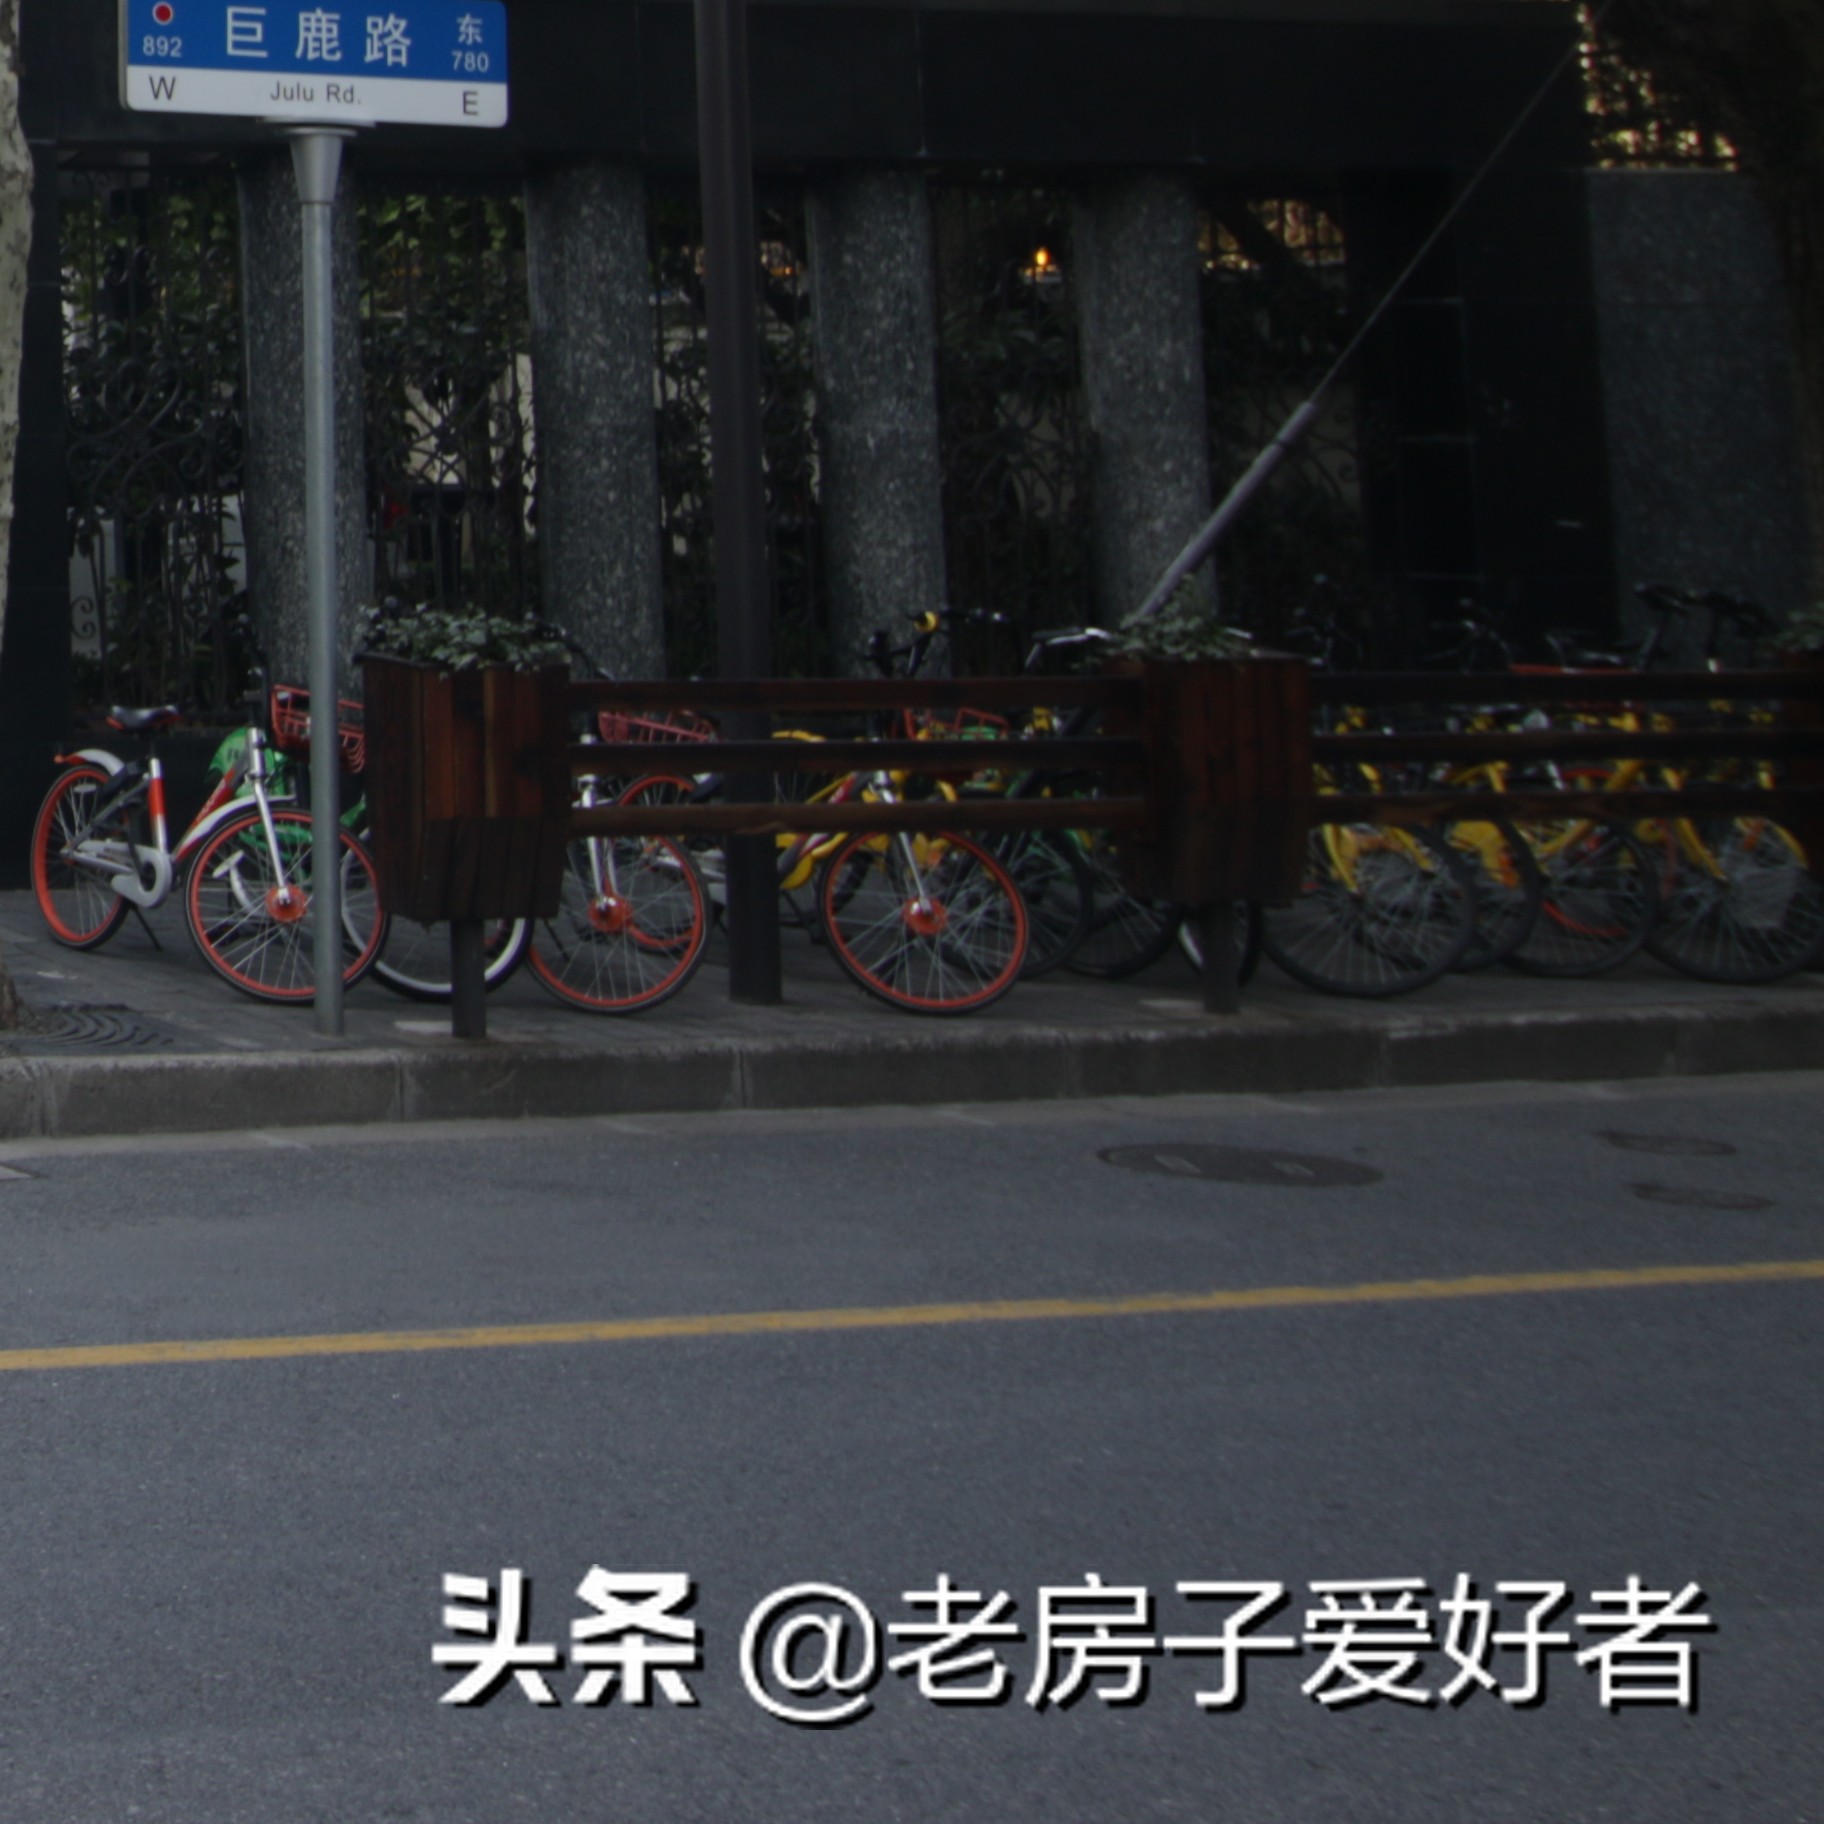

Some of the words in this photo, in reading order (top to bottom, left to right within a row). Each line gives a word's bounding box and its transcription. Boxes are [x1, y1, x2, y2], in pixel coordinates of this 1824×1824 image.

[226, 5, 412, 68] 巨鹿路
[456, 13, 483, 46] 东
[142, 34, 183, 58] 892
[451, 50, 490, 73] 780
[148, 76, 177, 101] W
[270, 80, 315, 103] Julu
[326, 83, 362, 105] Rd.
[462, 90, 479, 116] E
